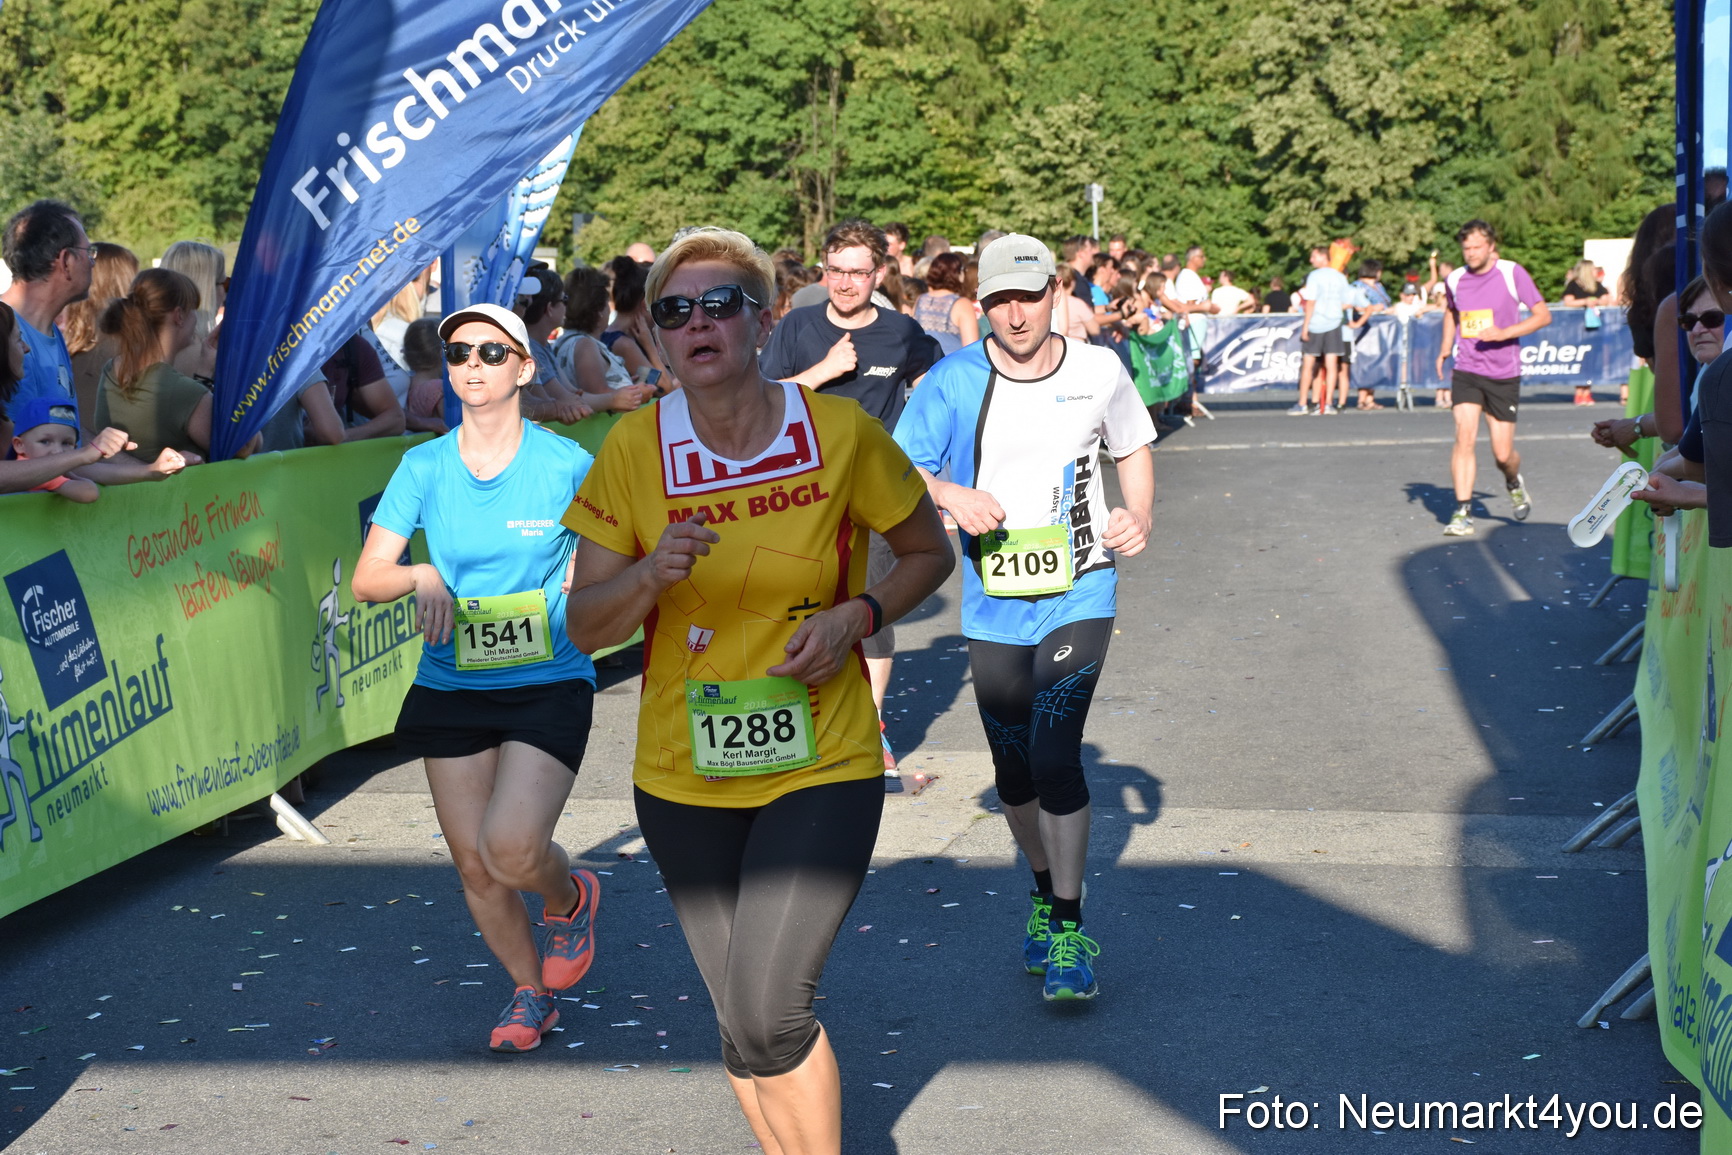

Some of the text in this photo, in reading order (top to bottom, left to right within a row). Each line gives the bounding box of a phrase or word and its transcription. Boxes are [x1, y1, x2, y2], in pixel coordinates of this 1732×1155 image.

[505, 20, 587, 94] Druck
[231, 215, 421, 424] www.frischmann-net.de
[1245, 346, 1303, 369] Fisc
[1519, 340, 1593, 363] cher
[1520, 363, 1582, 376] OMOBILE
[573, 495, 619, 528] x-boegl.de
[748, 481, 830, 519] BÖGL
[127, 489, 265, 579] Gesunde Firmen
[514, 519, 555, 528] PFLEIDERER
[521, 529, 544, 537] Maria
[173, 521, 286, 621] laufen länger!
[990, 550, 1059, 577] 2109
[32, 598, 77, 635] Fischer
[348, 595, 424, 670] firmen
[44, 620, 81, 648] AUTOMOBILE
[464, 617, 534, 650] 1541
[490, 653, 522, 662] Deutschland
[523, 650, 539, 658] GmbH
[498, 647, 520, 655] Maria
[351, 649, 403, 697] neumarkt
[25, 633, 175, 790] firmenlauf
[697, 695, 738, 705] firmenlauf
[700, 709, 796, 749] 1288
[720, 760, 736, 768] Bögl
[736, 757, 774, 767] Bauservice
[775, 753, 797, 762] GmbH
[722, 747, 777, 760] Kerl Margit
[47, 761, 109, 827] neumarkt
